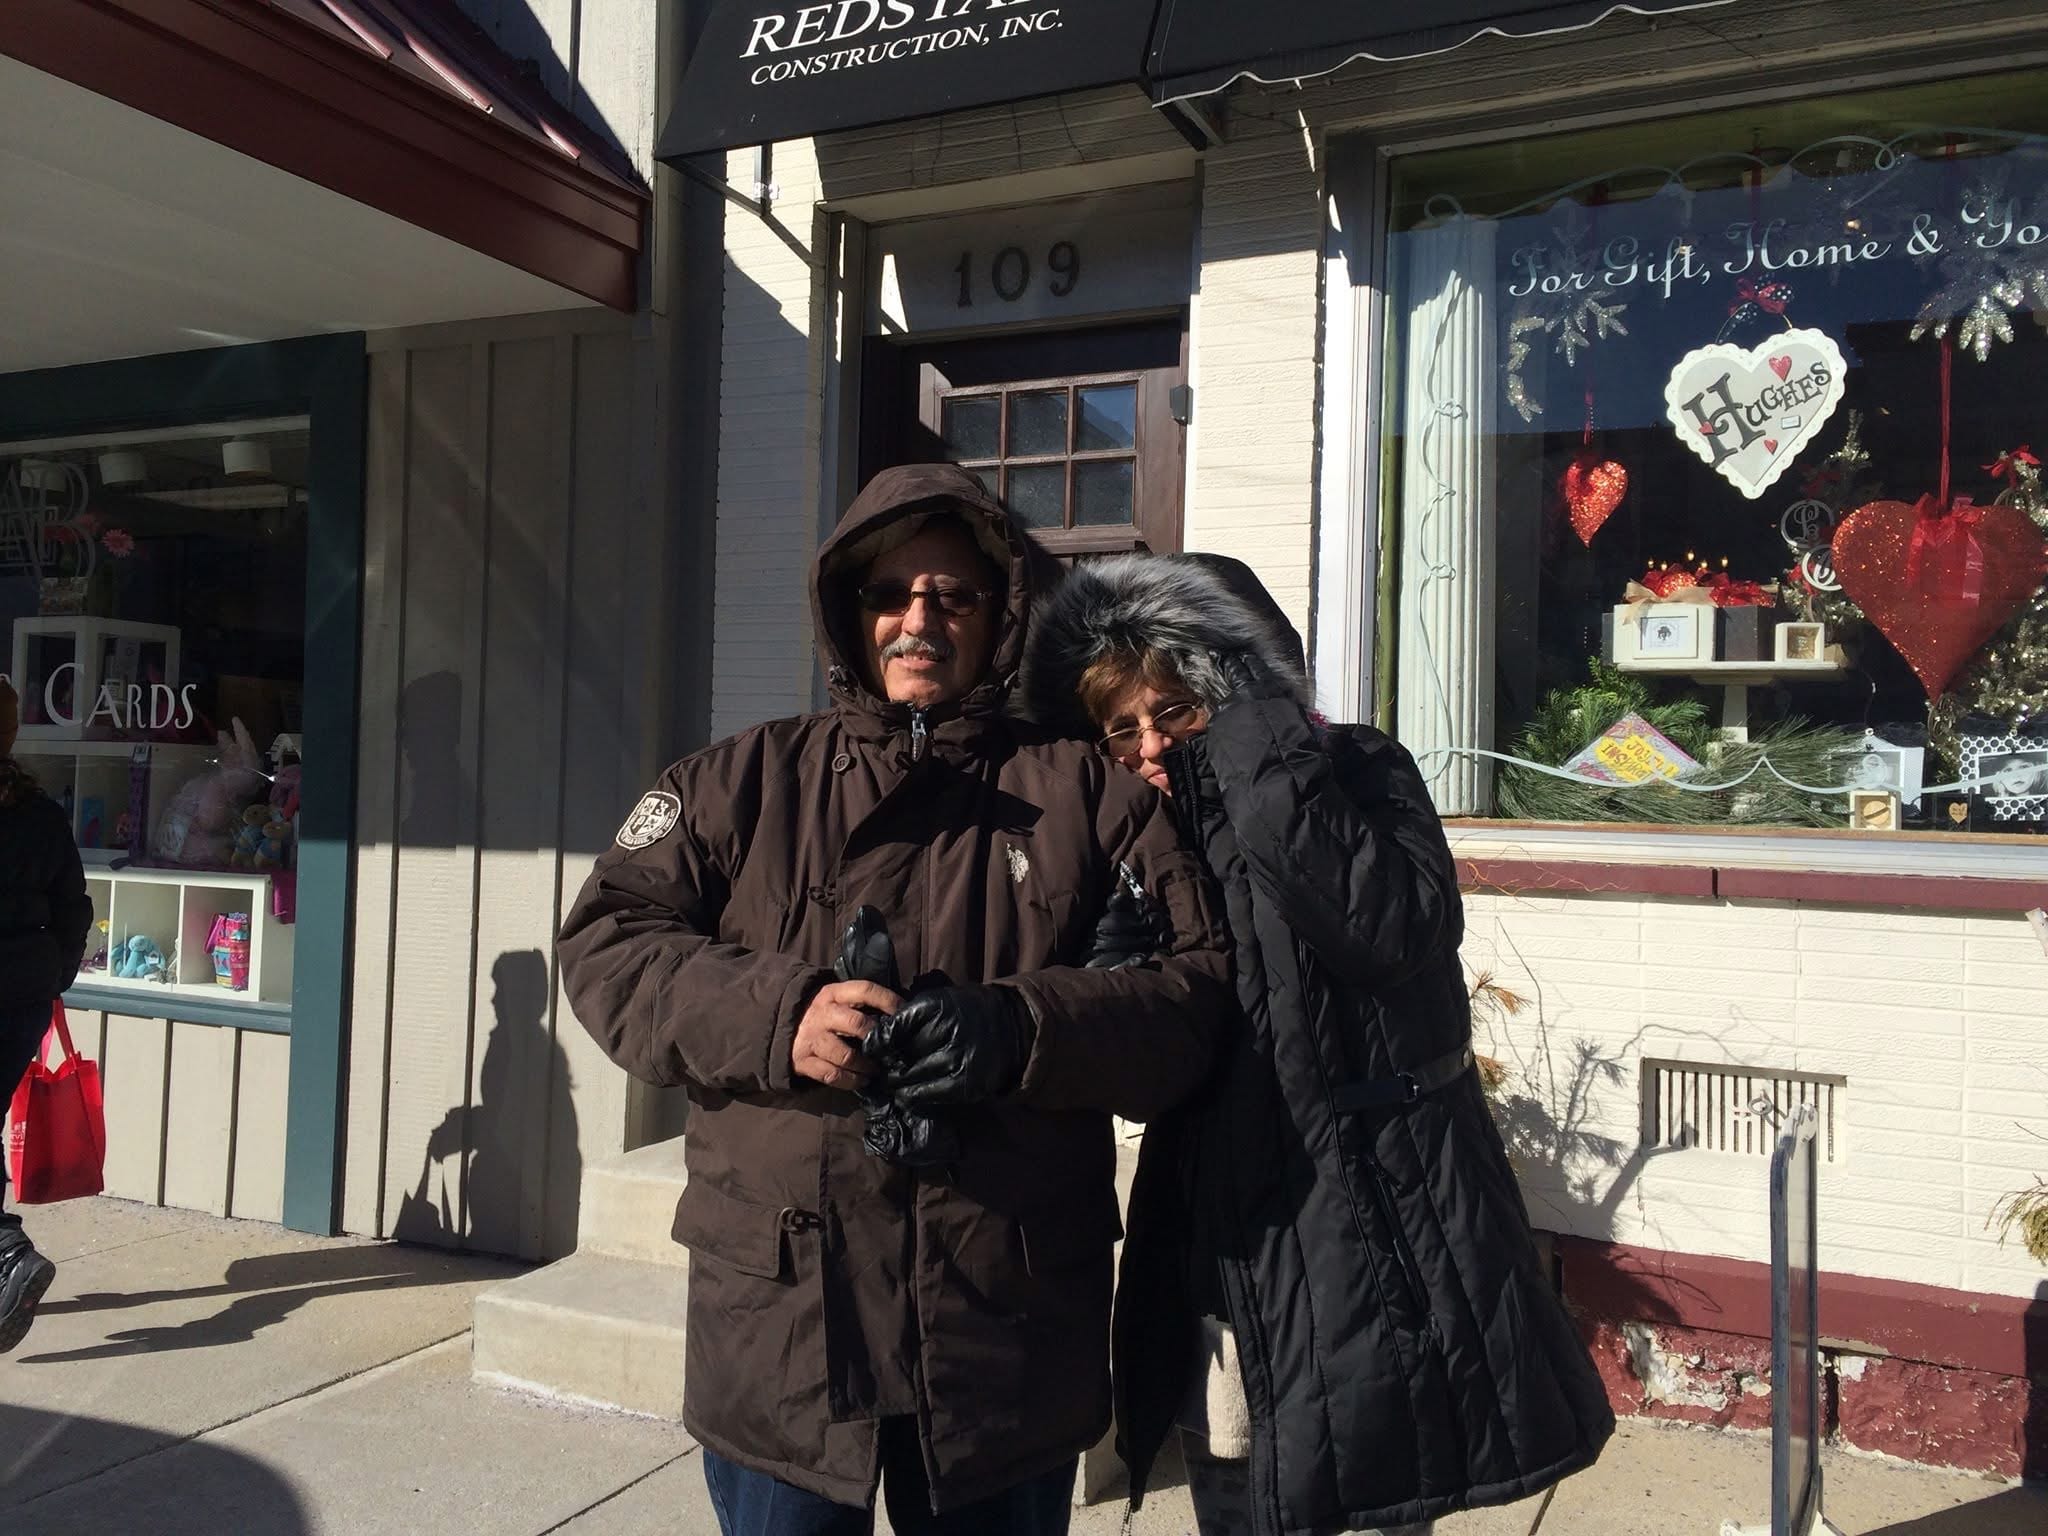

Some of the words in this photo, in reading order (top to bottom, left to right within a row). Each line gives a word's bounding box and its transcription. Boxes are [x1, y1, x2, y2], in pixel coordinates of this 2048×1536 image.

[751, 23, 990, 85] CONSTRUCTION,
[999, 9, 1064, 39] INC.
[953, 240, 1080, 309] 109
[1508, 246, 1595, 297] For
[1603, 235, 1711, 299] Gift,
[1723, 218, 1892, 274] Home
[1906, 213, 1943, 255] &
[1961, 196, 2048, 249] Yo
